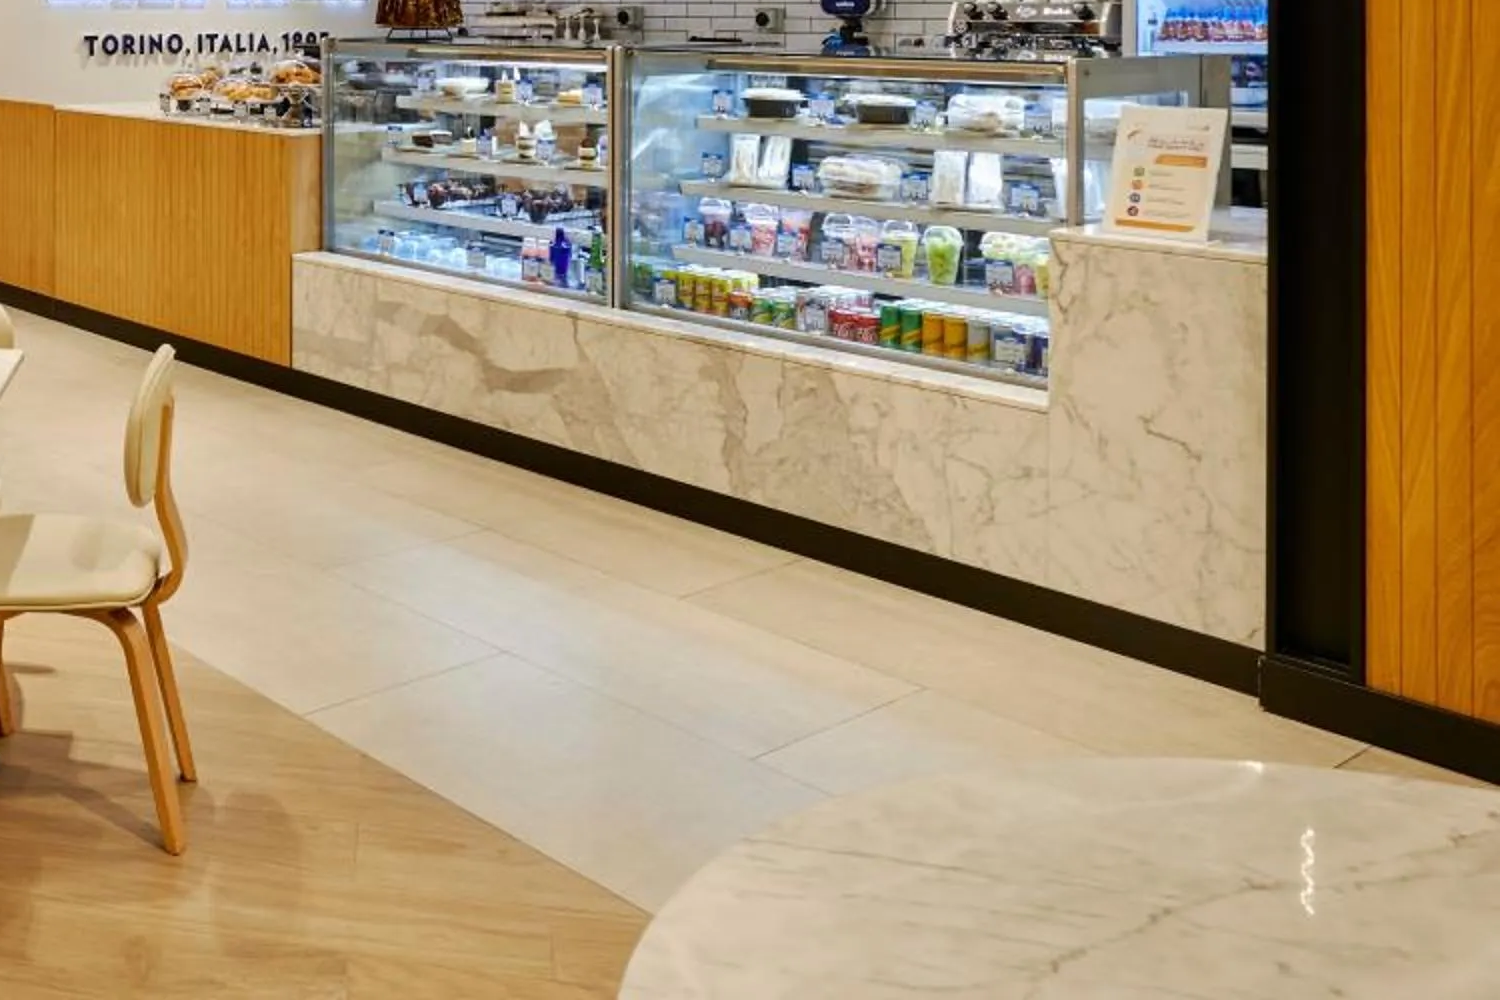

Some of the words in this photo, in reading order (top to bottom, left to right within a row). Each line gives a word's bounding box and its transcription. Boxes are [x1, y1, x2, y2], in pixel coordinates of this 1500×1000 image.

[83, 33, 191, 57] TORINO,
[197, 32, 278, 55] ITALIA,
[281, 31, 330, 53] 189
